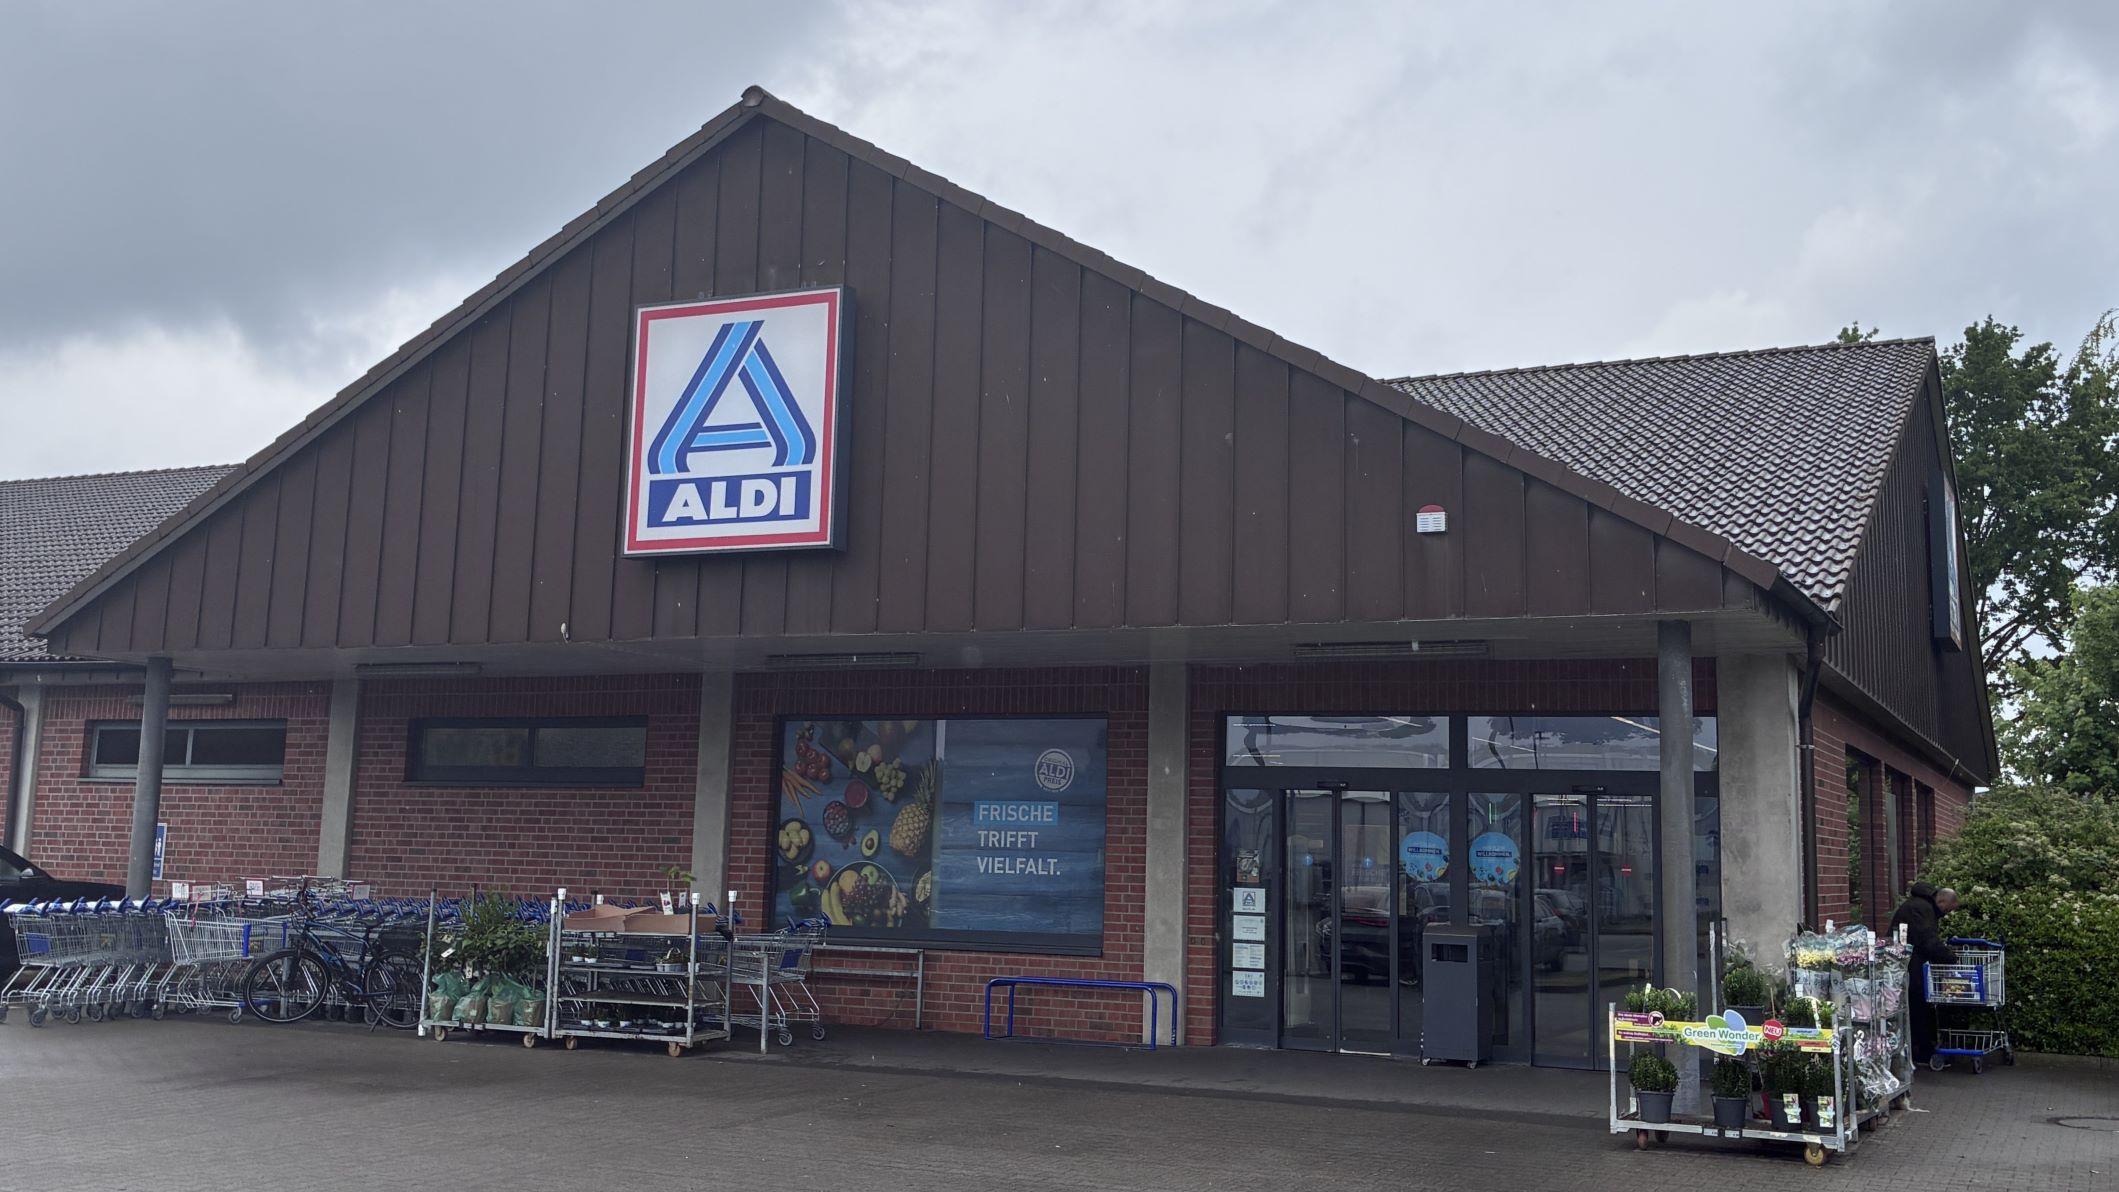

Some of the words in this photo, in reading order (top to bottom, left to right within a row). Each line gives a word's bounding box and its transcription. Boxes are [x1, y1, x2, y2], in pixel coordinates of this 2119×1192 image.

[662, 476, 797, 523] ALDI
[1039, 762, 1071, 781] ALDI
[979, 804, 1054, 822] FRISCHE
[978, 830, 1039, 848] TRIFFT
[977, 856, 1061, 875] VIELFALT.
[1684, 1027, 1716, 1039] Green
[1718, 1029, 1760, 1041] Wonder
[1764, 1025, 1783, 1036] NEU
